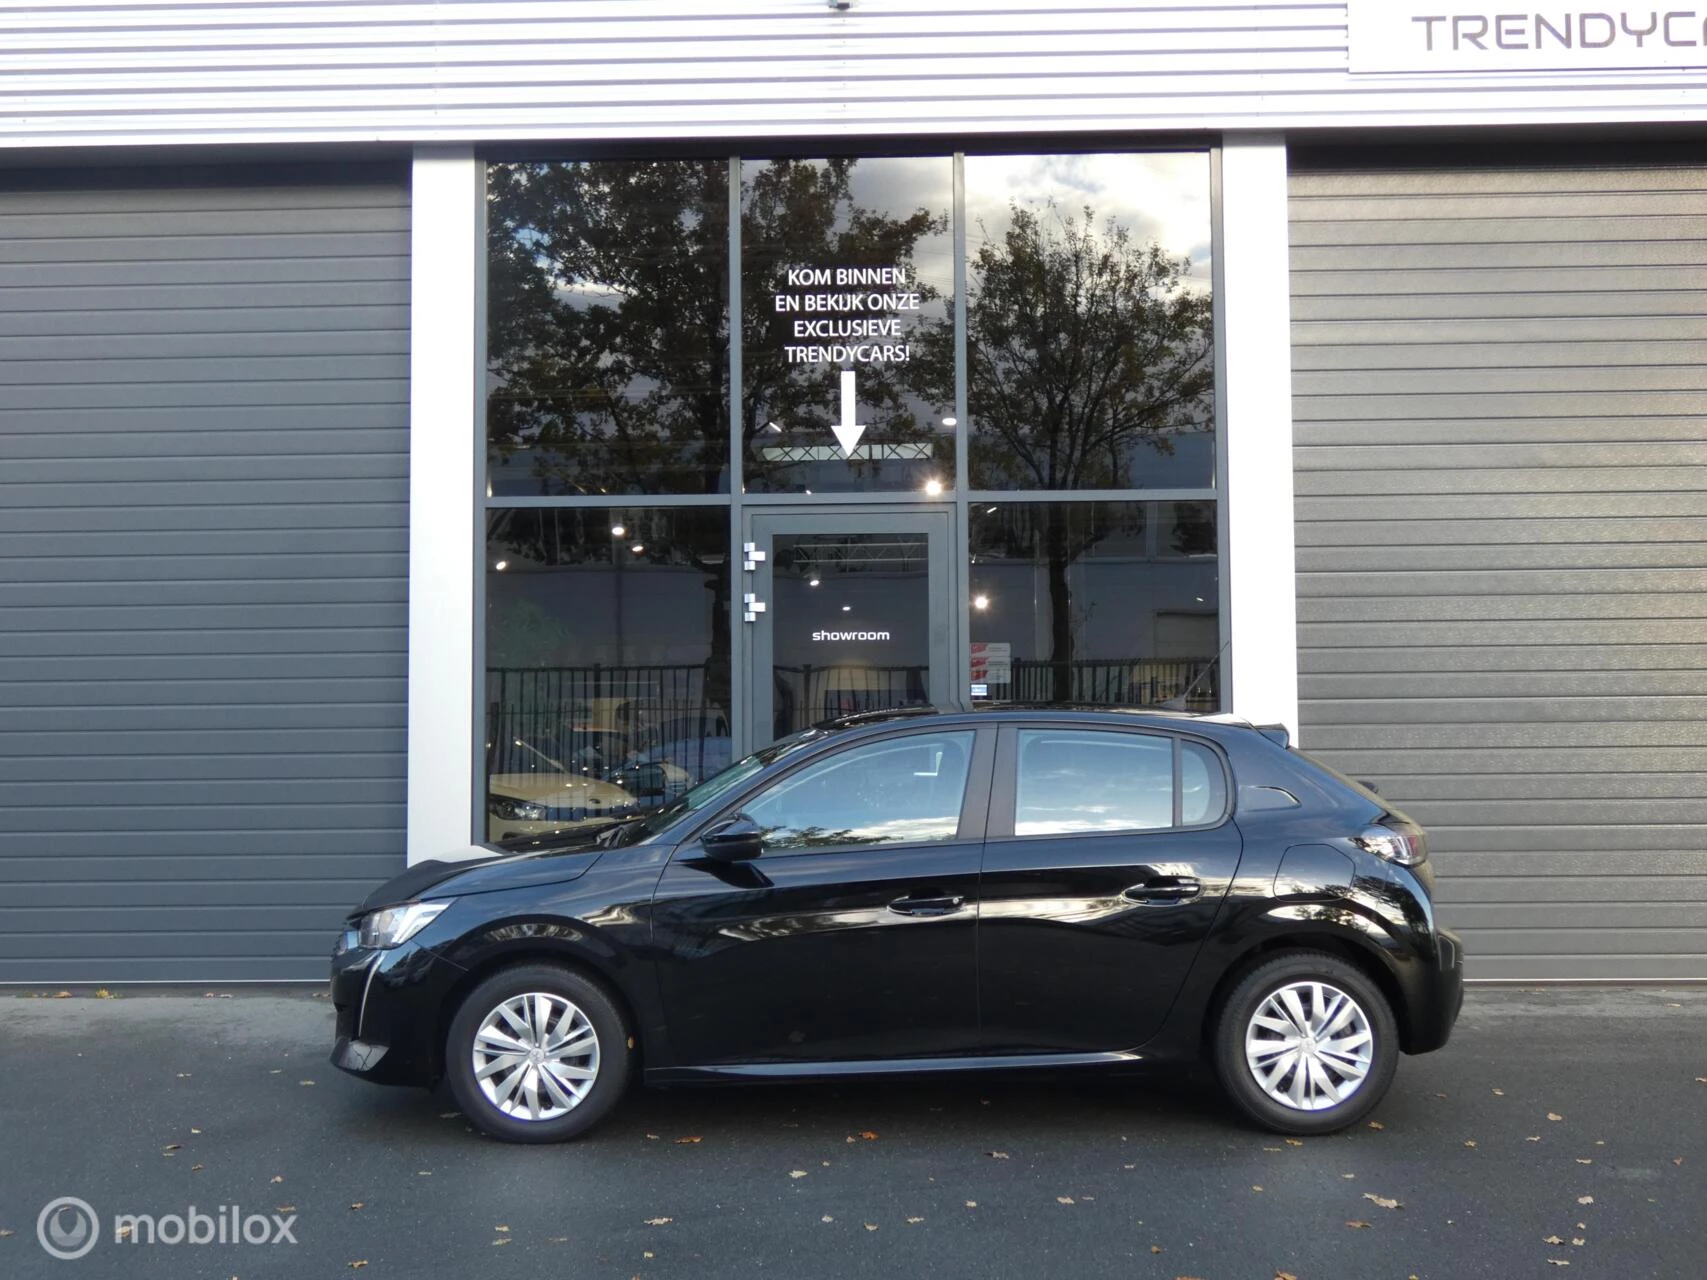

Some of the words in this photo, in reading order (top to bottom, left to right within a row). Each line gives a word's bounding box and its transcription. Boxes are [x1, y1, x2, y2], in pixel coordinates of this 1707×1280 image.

[1411, 11, 1707, 51] TRENDYC
[788, 269, 831, 286] KOM
[836, 268, 906, 285] BINNEN
[775, 295, 799, 312] EN
[805, 294, 864, 311] BEKIJK
[868, 293, 920, 310] ONZE
[794, 319, 901, 337] EXCLUSIEVE
[784, 345, 910, 363] TRENDYCARS!
[812, 630, 890, 641] showroom
